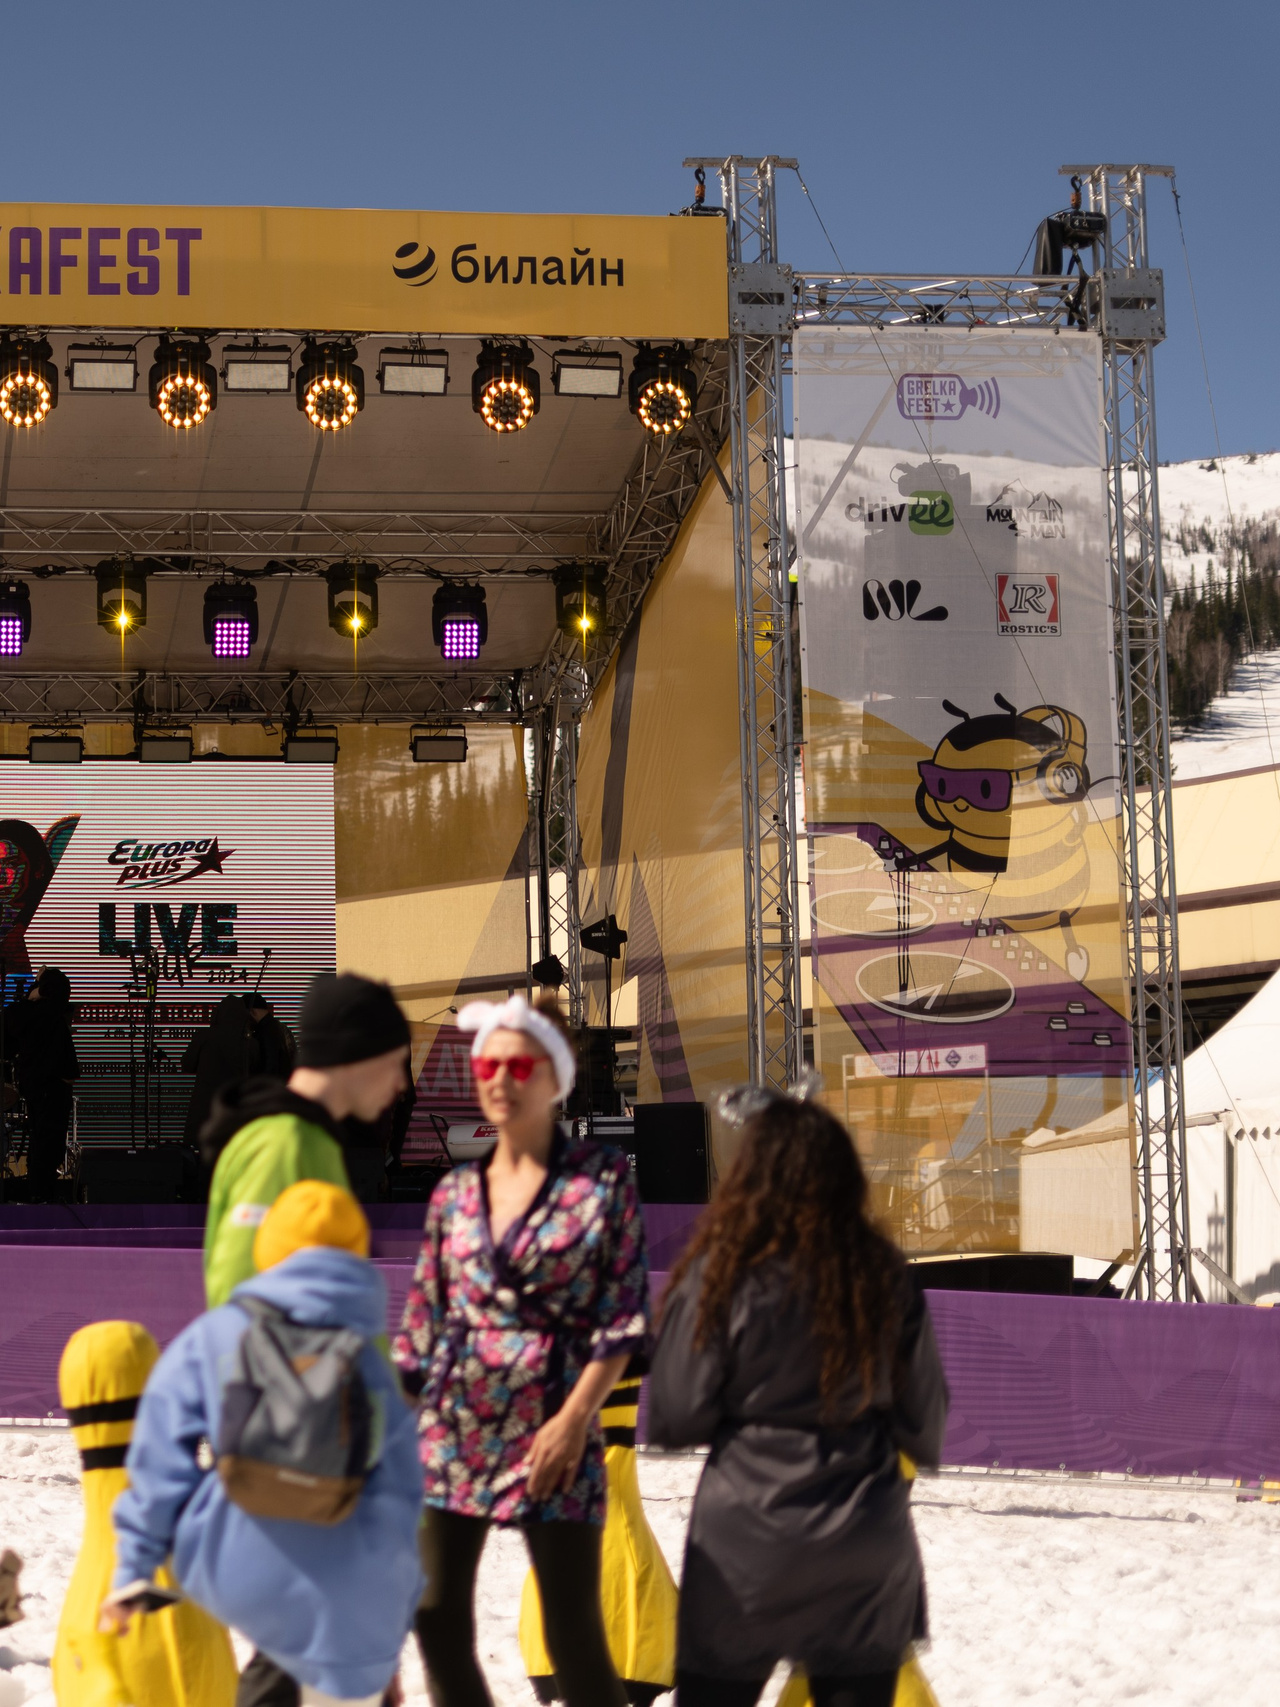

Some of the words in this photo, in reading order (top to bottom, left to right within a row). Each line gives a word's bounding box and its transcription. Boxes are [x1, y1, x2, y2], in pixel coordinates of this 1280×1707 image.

[451, 242, 625, 287] билайн
[907, 380, 957, 396] GRELKA
[907, 397, 940, 413] FEST
[844, 496, 955, 528] drivee
[986, 508, 1064, 523] MOUNTAIN
[1030, 524, 1066, 539] MAN
[1009, 583, 1047, 614] R
[1000, 625, 1059, 634] ROSTIC'S
[107, 838, 213, 866] Europa
[98, 903, 238, 957] LIVE
